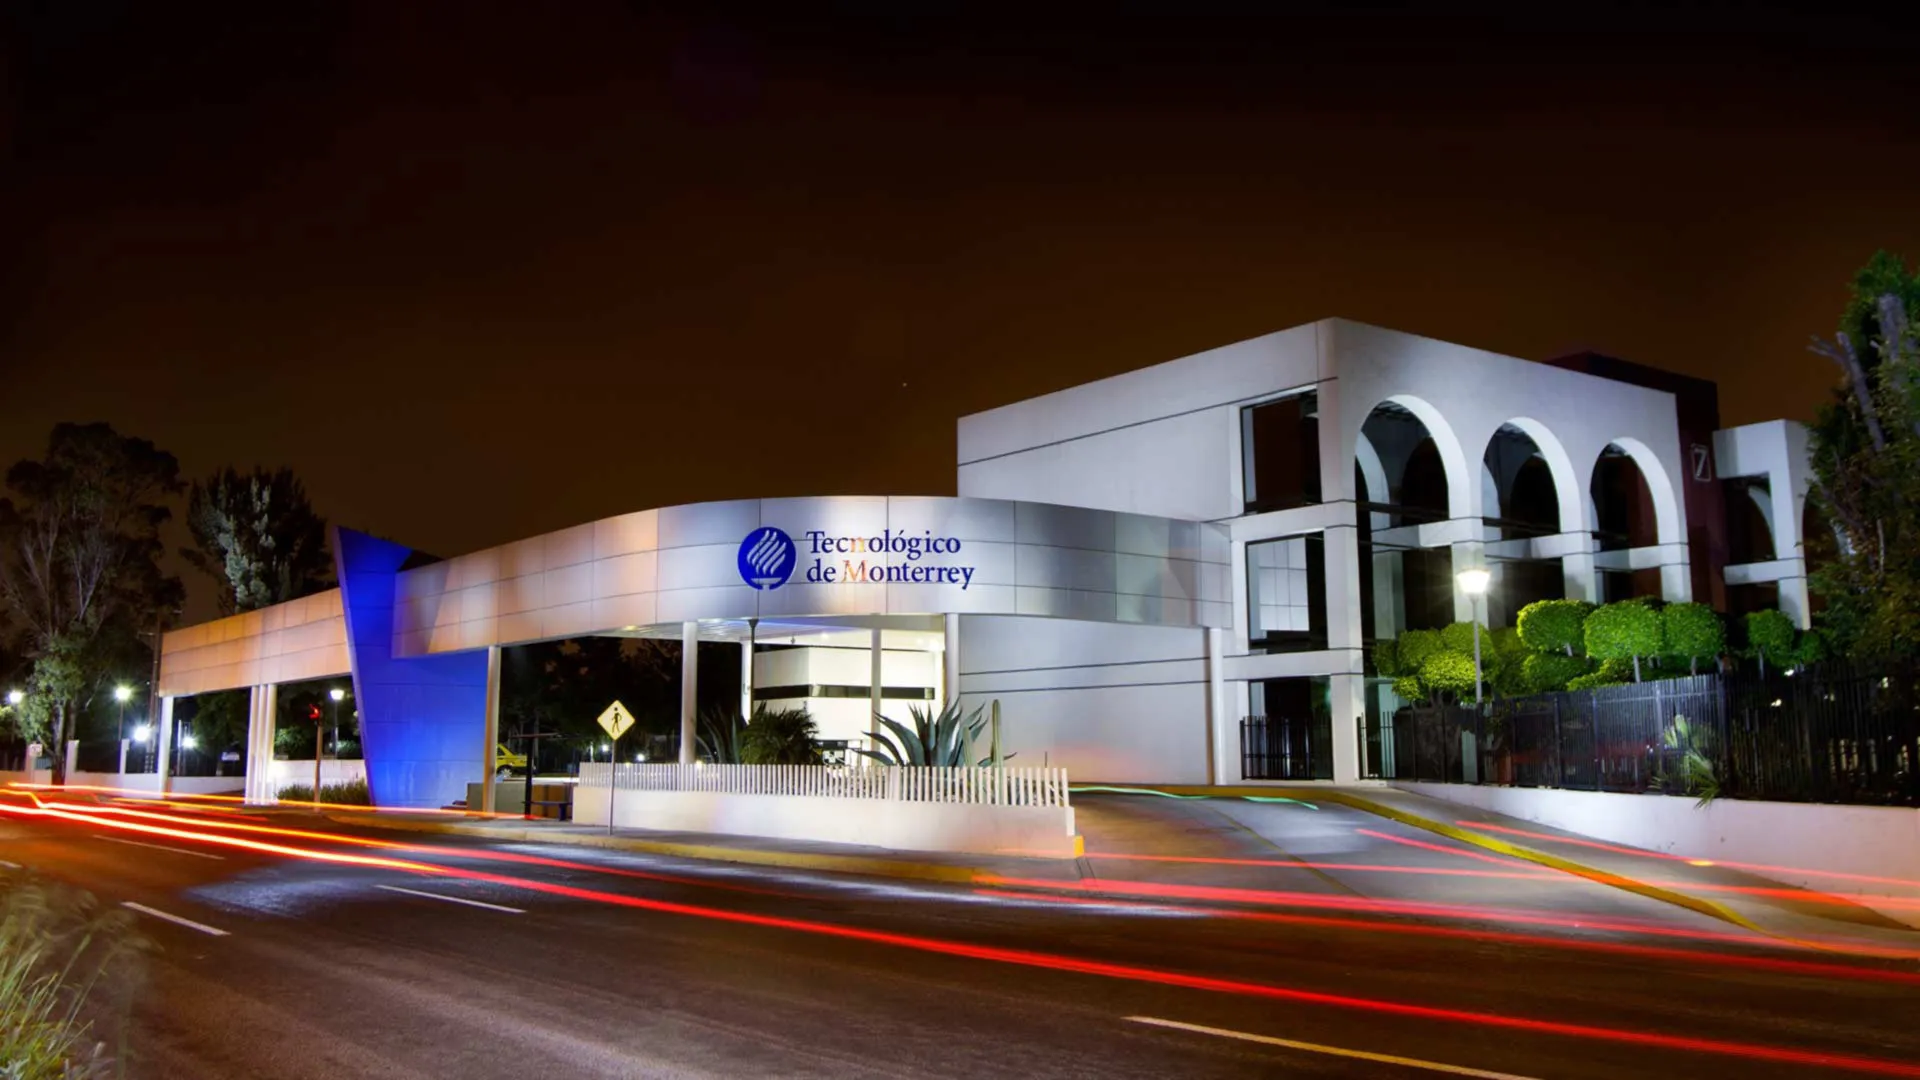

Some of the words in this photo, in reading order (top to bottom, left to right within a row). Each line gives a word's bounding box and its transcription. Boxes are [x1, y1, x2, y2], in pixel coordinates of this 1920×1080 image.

[805, 529, 961, 560] Tecnológico
[806, 559, 836, 583] de
[841, 559, 975, 590] Monterrey
